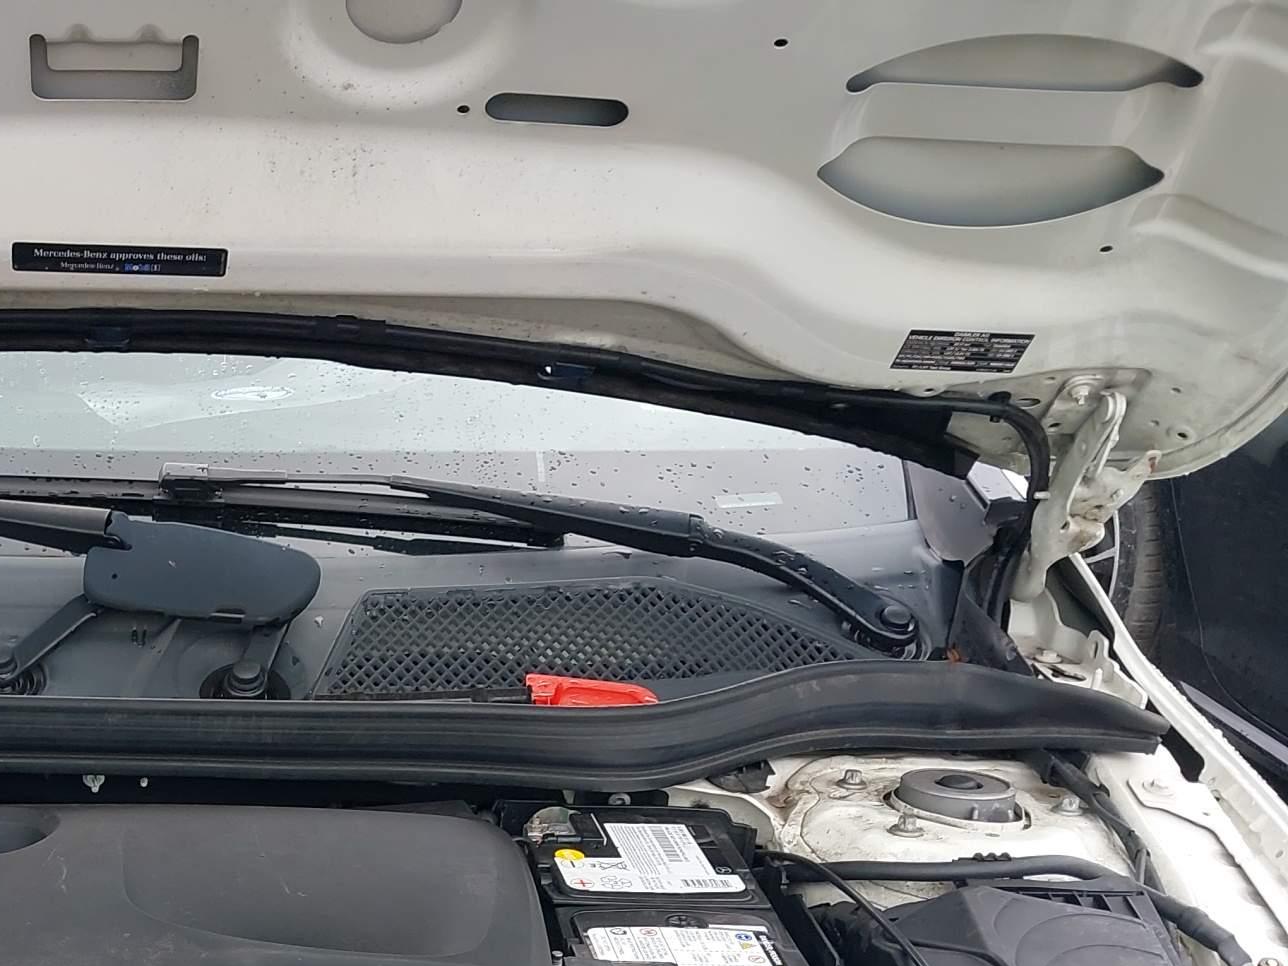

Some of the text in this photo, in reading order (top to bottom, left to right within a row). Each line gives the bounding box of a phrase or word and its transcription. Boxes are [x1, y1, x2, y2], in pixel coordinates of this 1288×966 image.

[33, 248, 108, 259] Mercedes-Benz
[110, 252, 154, 261] approves
[157, 252, 183, 260] these
